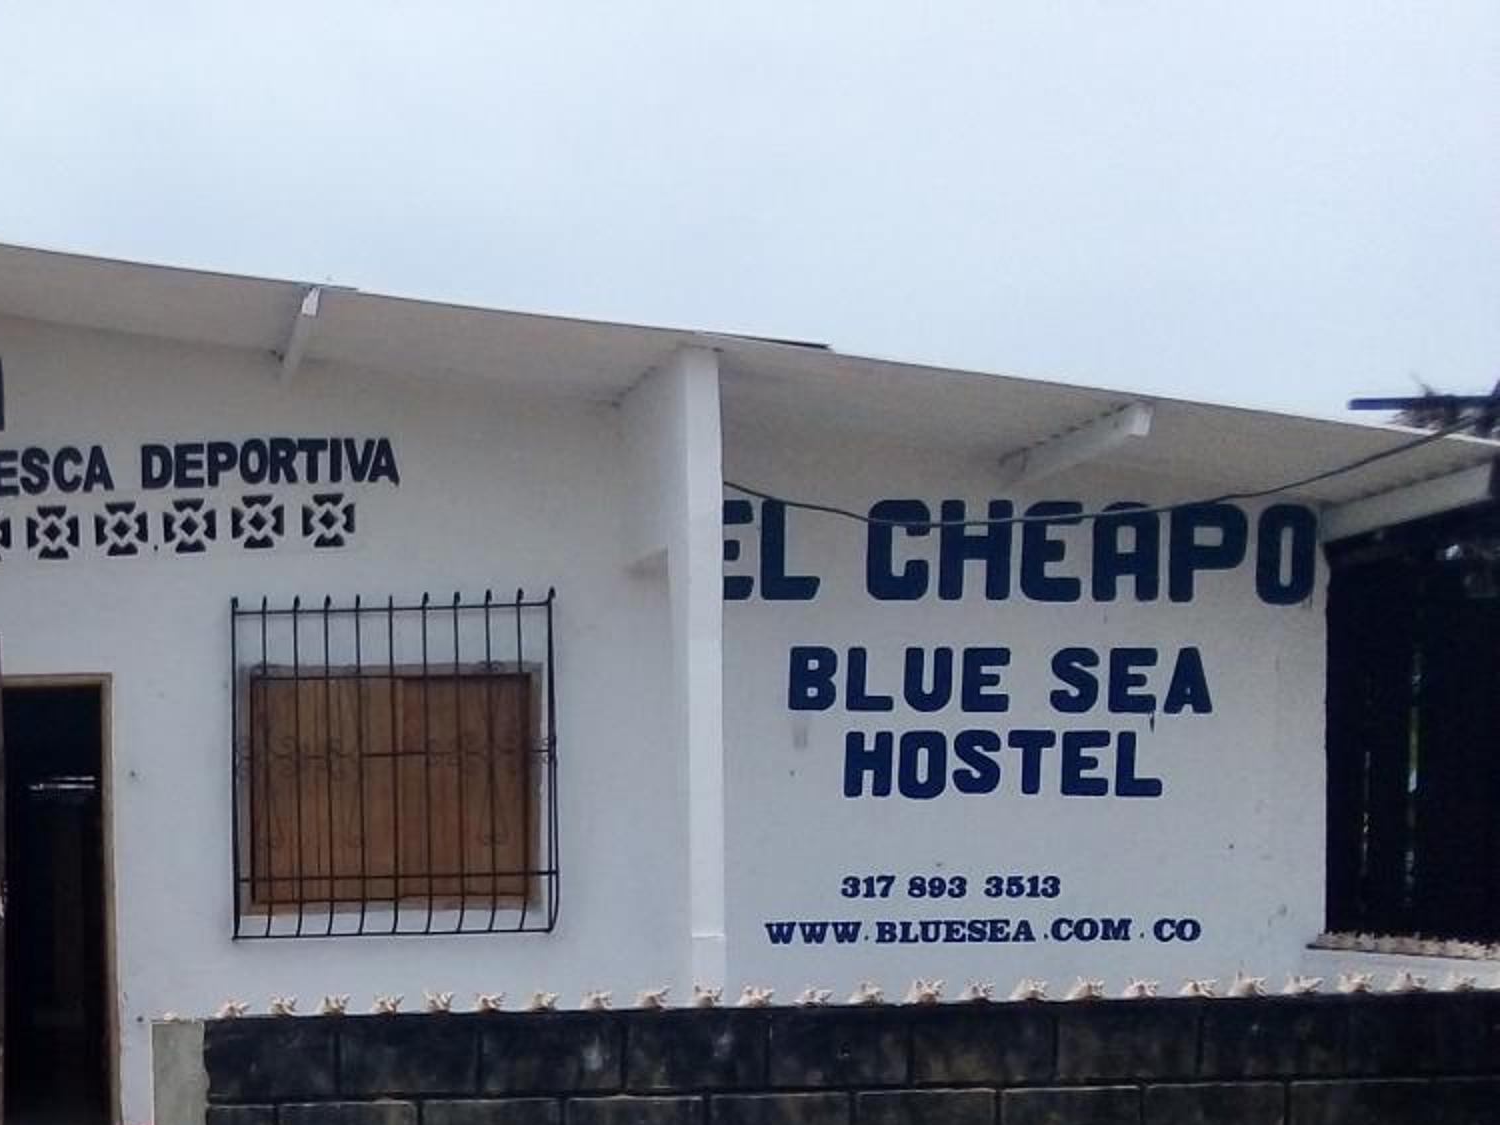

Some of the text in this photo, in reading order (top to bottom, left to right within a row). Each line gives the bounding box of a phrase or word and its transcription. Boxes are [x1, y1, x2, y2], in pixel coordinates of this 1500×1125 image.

[141, 437, 400, 489] DEPORTIVA
[722, 499, 1318, 606] EL CHEAPO
[787, 646, 1213, 714] BLUE SEA
[844, 729, 1163, 799] HOSTEL
[841, 875, 1061, 898] 317 893 3513
